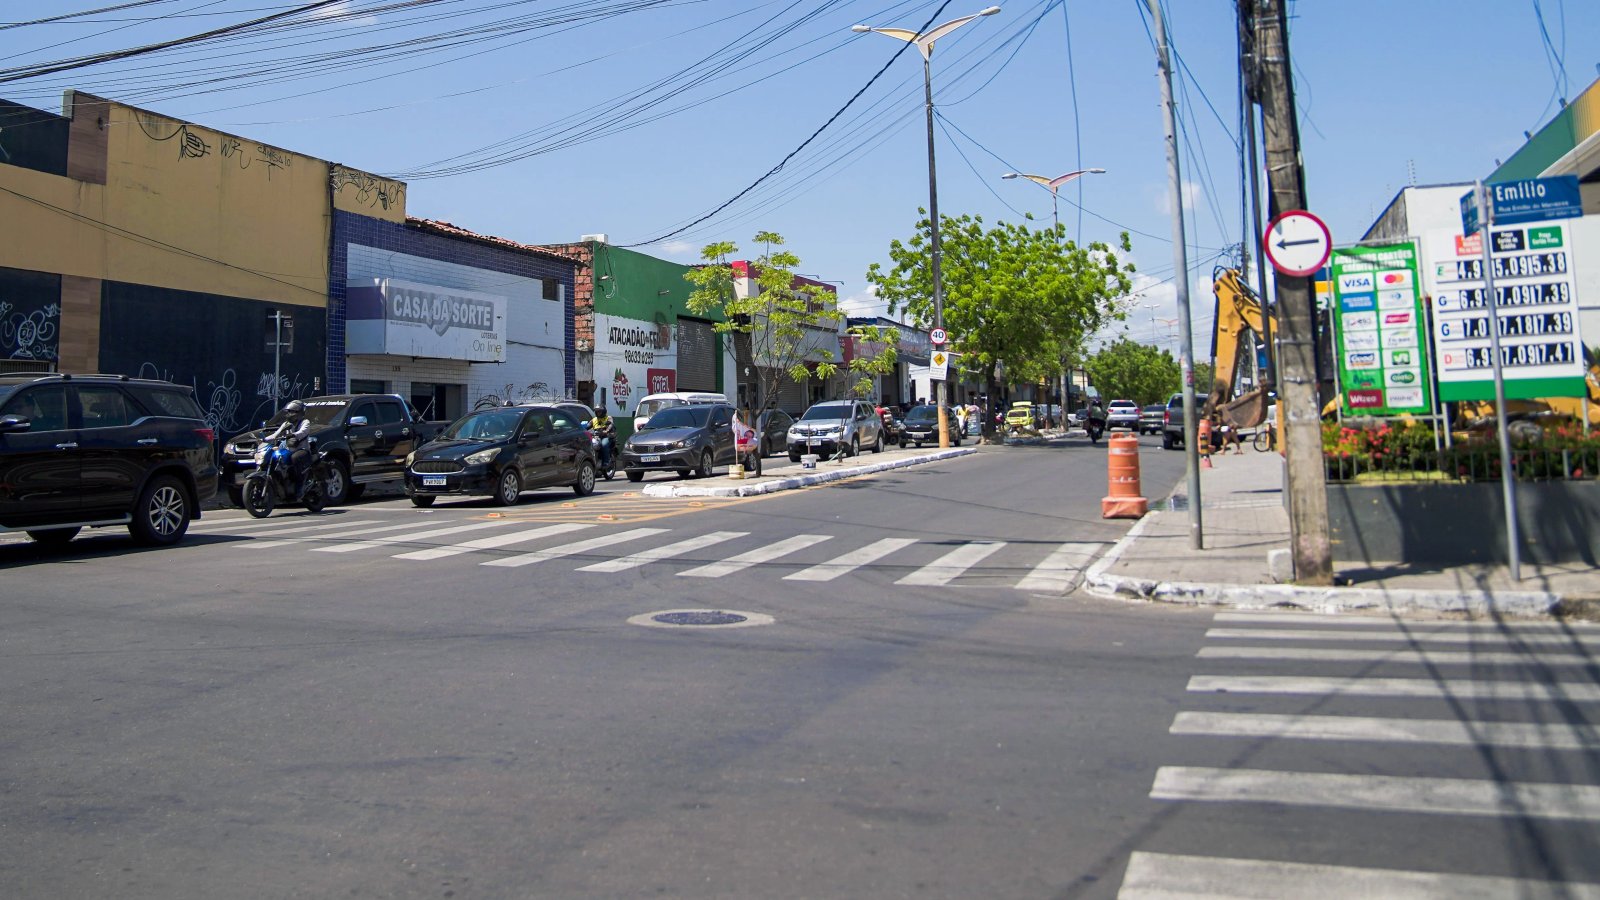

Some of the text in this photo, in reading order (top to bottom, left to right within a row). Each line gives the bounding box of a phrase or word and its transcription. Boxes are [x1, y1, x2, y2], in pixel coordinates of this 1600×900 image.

[1496, 181, 1546, 201] Emílio
[1532, 252, 1566, 274] 5.38
[1344, 278, 1370, 287] VISA
[1535, 282, 1568, 303] 7.39
[1438, 296, 1447, 306] G
[394, 294, 491, 326] CASA DA SORTE
[1441, 323, 1450, 336] G
[1538, 312, 1571, 332] 7.39
[932, 331, 944, 339] 40
[473, 340, 502, 353] On line
